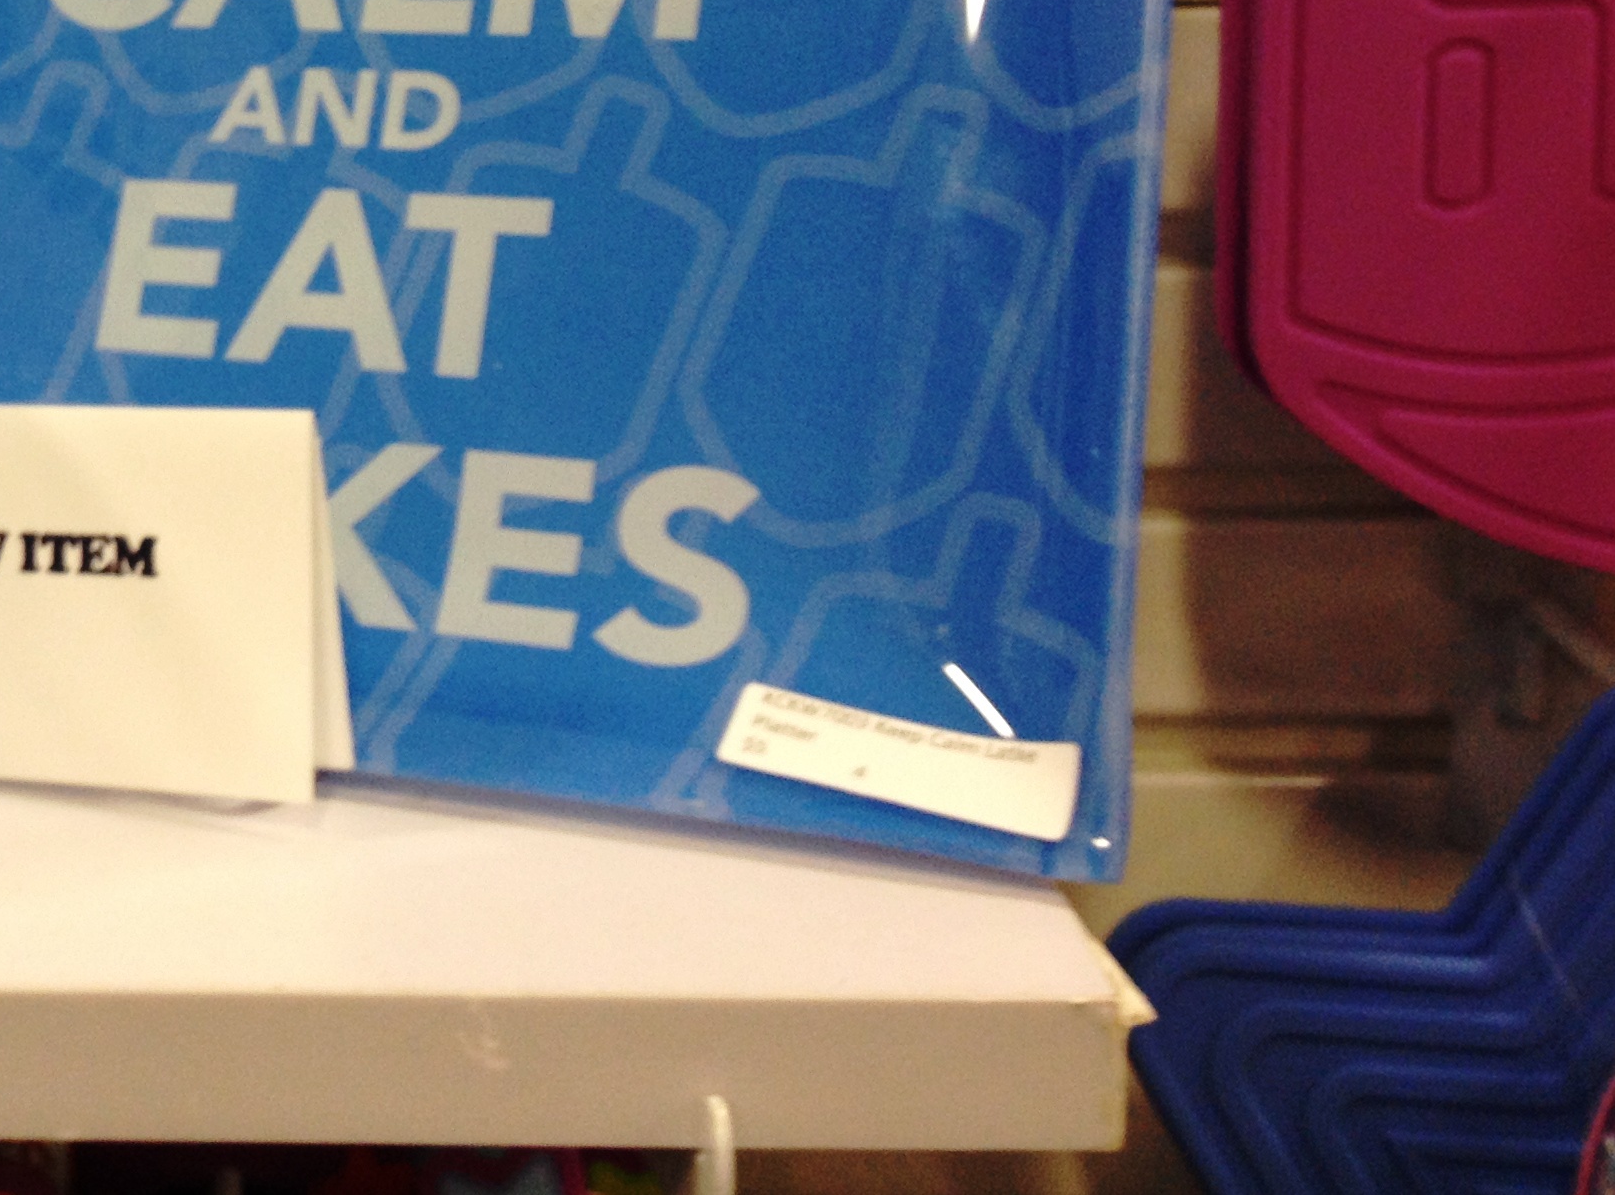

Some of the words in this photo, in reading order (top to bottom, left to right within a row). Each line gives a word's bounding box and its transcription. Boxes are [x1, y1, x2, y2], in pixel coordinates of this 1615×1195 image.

[207, 65, 461, 150] AND
[95, 177, 554, 379] EAT
[20, 530, 159, 578] ITEM
